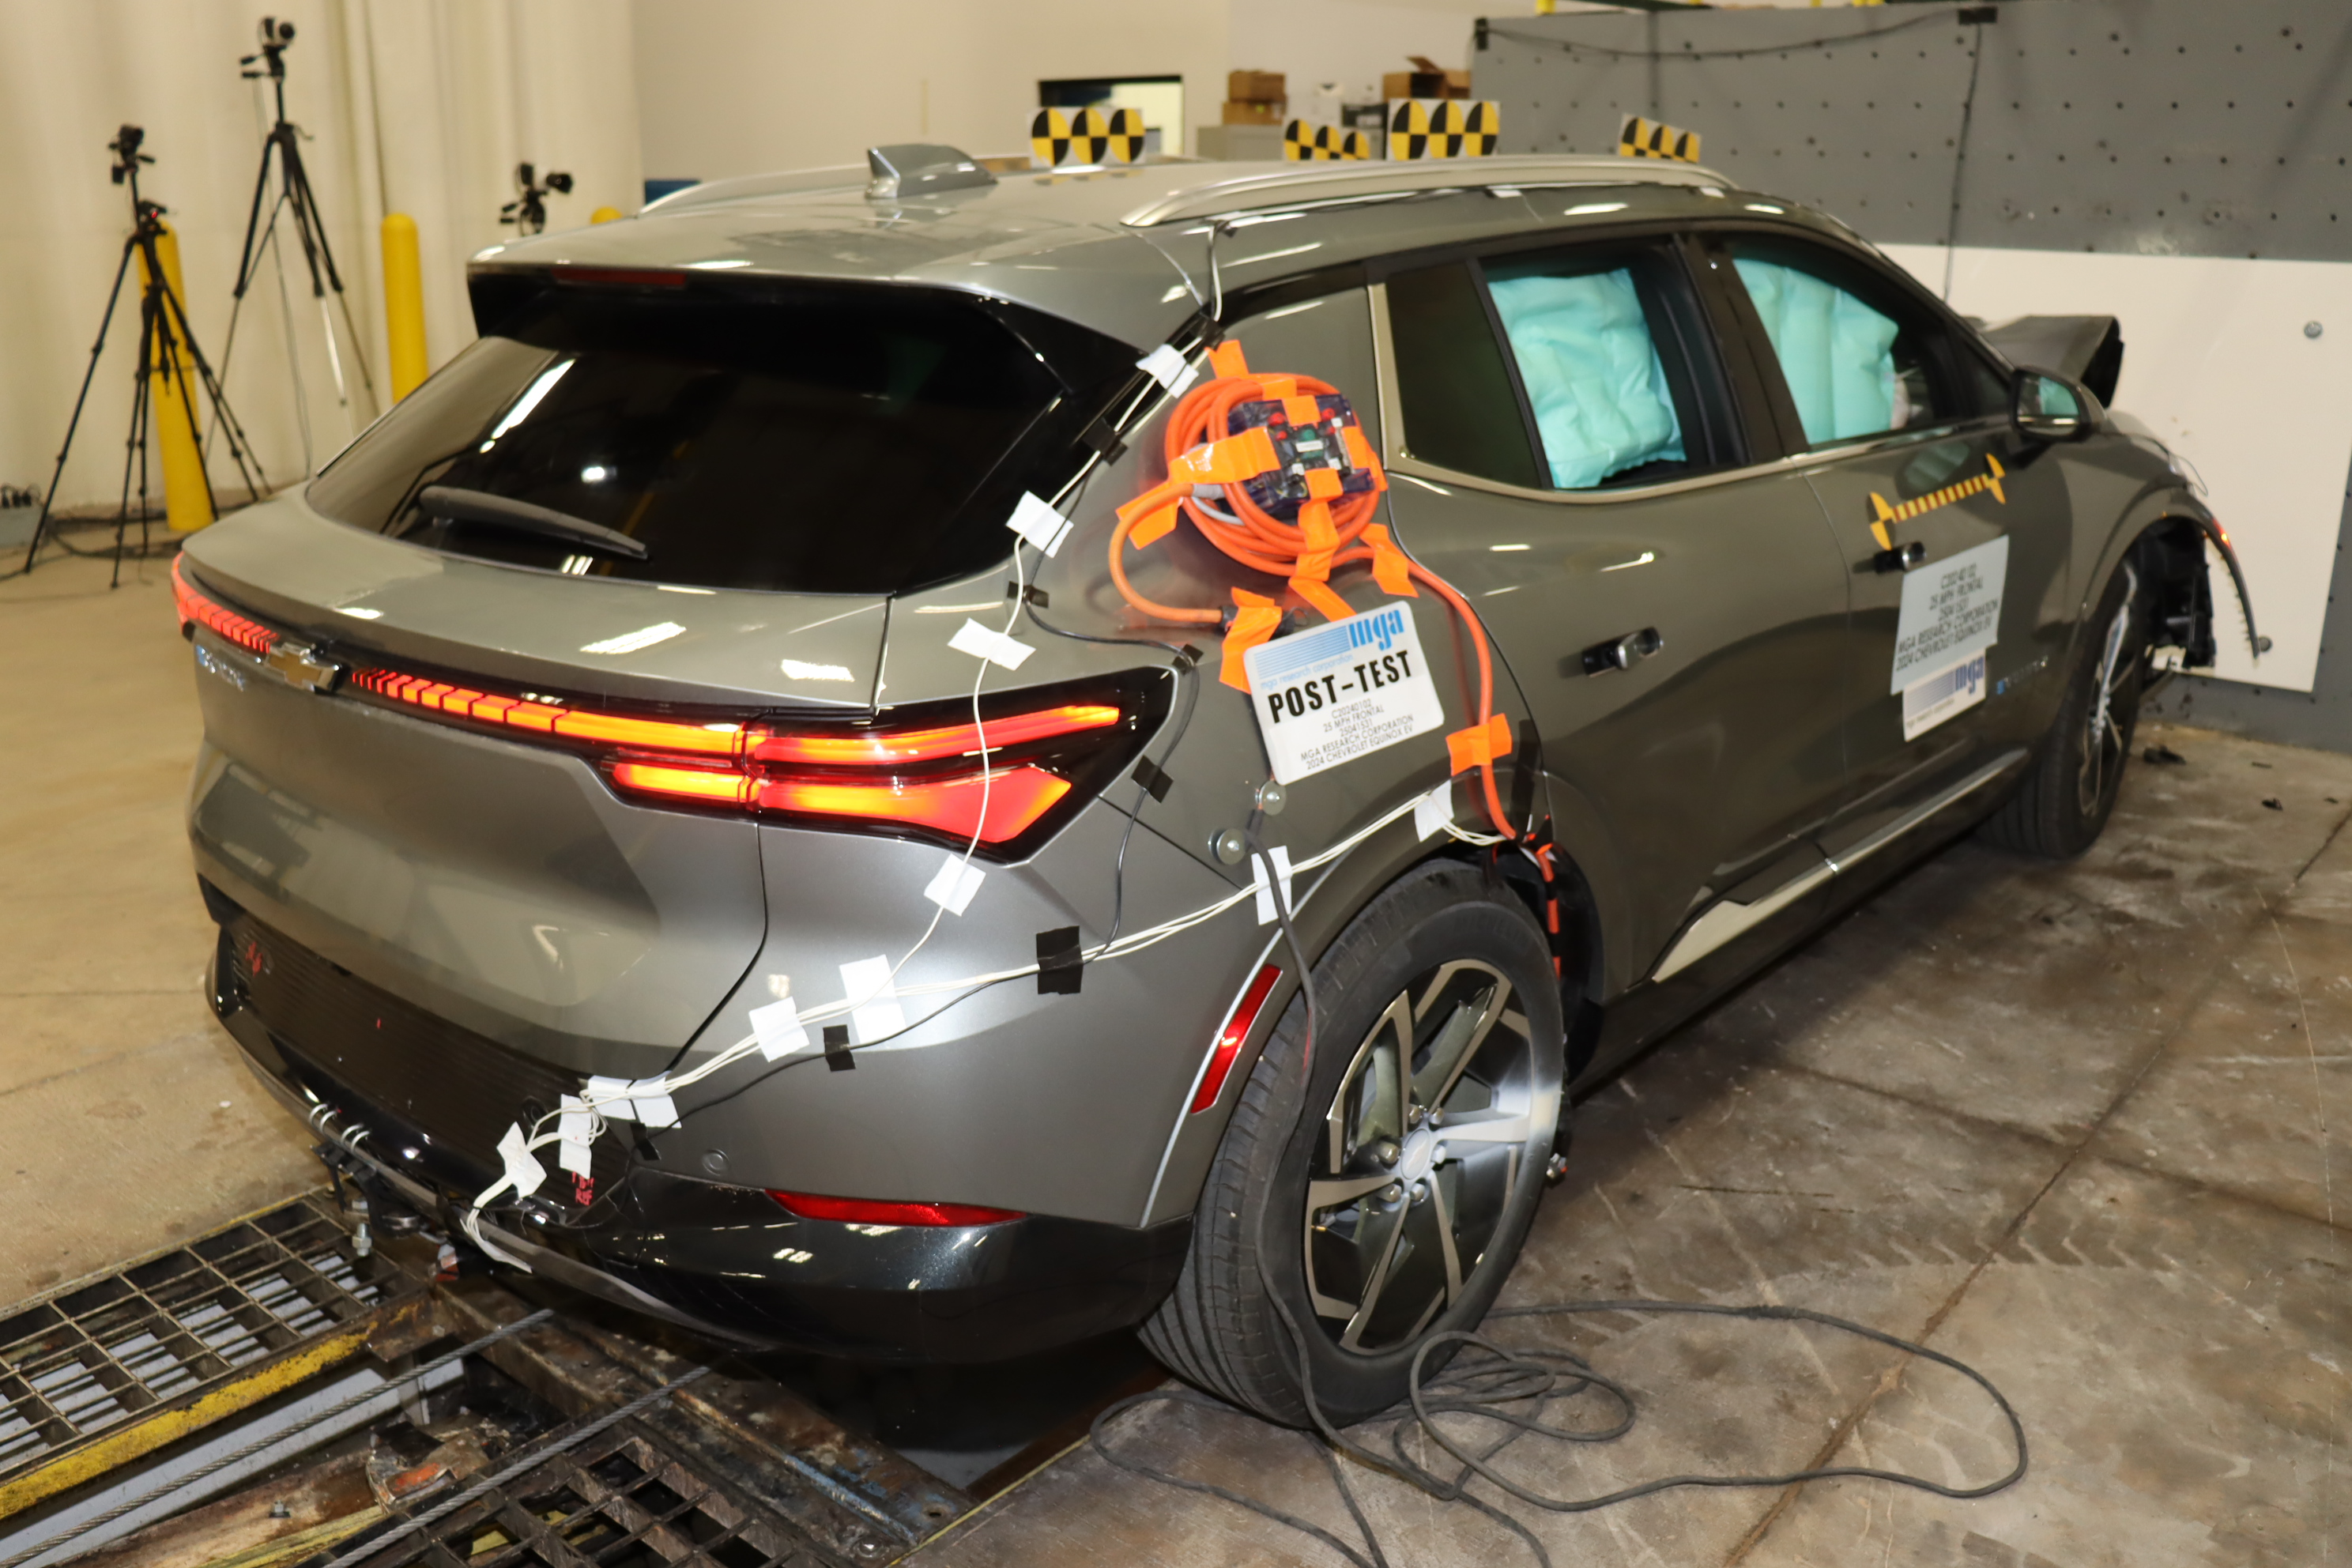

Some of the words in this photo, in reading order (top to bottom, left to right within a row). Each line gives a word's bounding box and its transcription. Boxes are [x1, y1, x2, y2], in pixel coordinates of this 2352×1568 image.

[1349, 610, 1404, 650] mga
[1260, 679, 1278, 691] mga
[1279, 665, 1311, 683] research
[1268, 650, 1411, 723] POST-TEST
[1323, 722, 1333, 733] 25
[1334, 717, 1351, 728] MPH
[1352, 706, 1385, 720] FRONTAL
[1332, 698, 1372, 719] C20240102
[1300, 748, 1321, 760] MGA
[1322, 734, 1360, 752] RESEARCH
[1362, 714, 1414, 739] CORPORATION
[1340, 718, 1373, 737] 25041531
[1306, 756, 1325, 770] 2024
[1326, 740, 1367, 763] CHEVROLET
[1369, 728, 1403, 747] EQUINOX
[1404, 724, 1413, 734] EV
